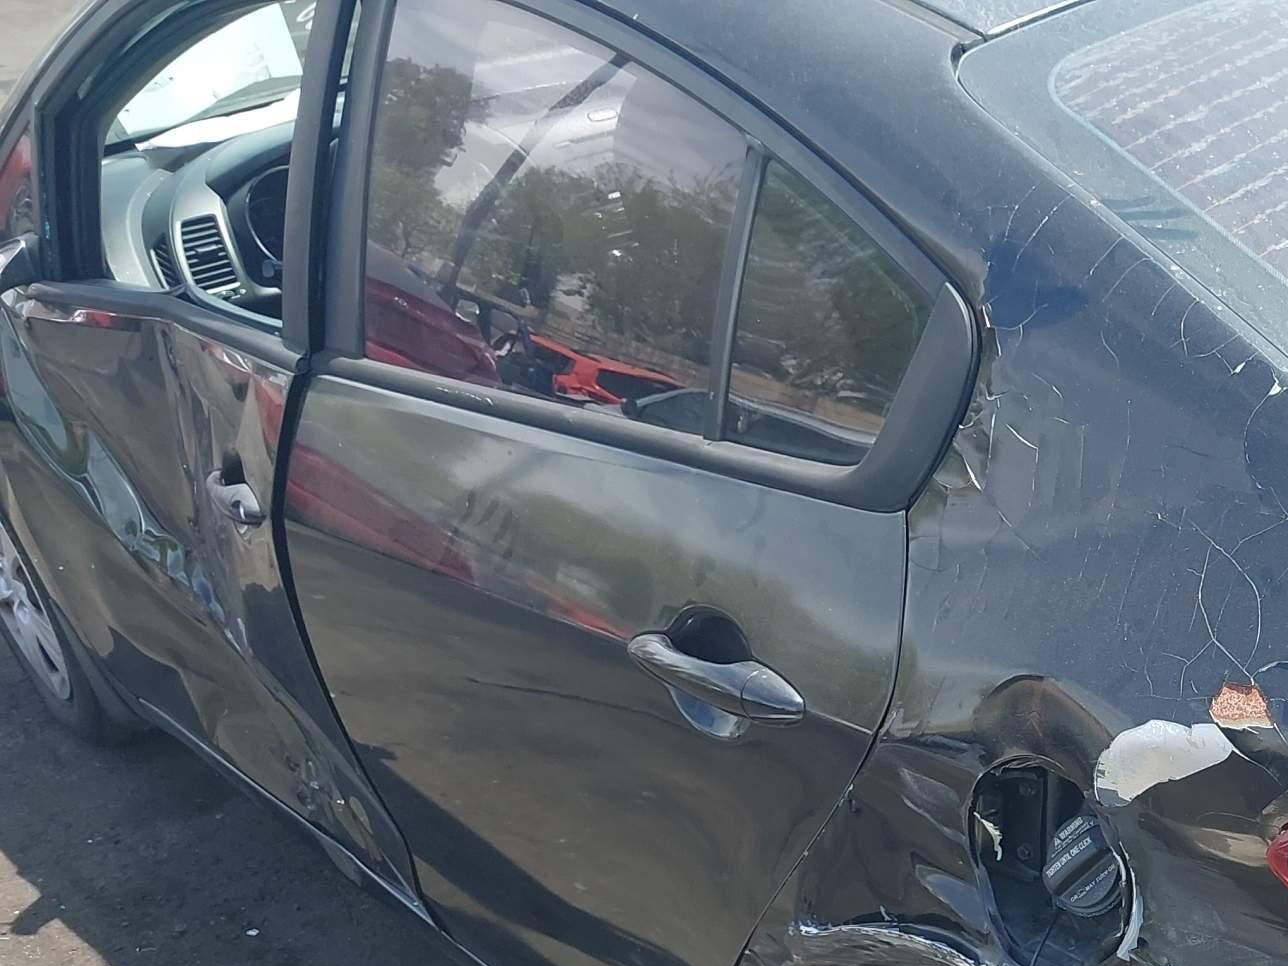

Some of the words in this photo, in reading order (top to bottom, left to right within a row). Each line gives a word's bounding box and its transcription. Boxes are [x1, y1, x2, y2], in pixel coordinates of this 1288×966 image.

[1058, 816, 1083, 839] WARNING
[1070, 846, 1080, 856] ONE
[1079, 836, 1092, 850] CLICK
